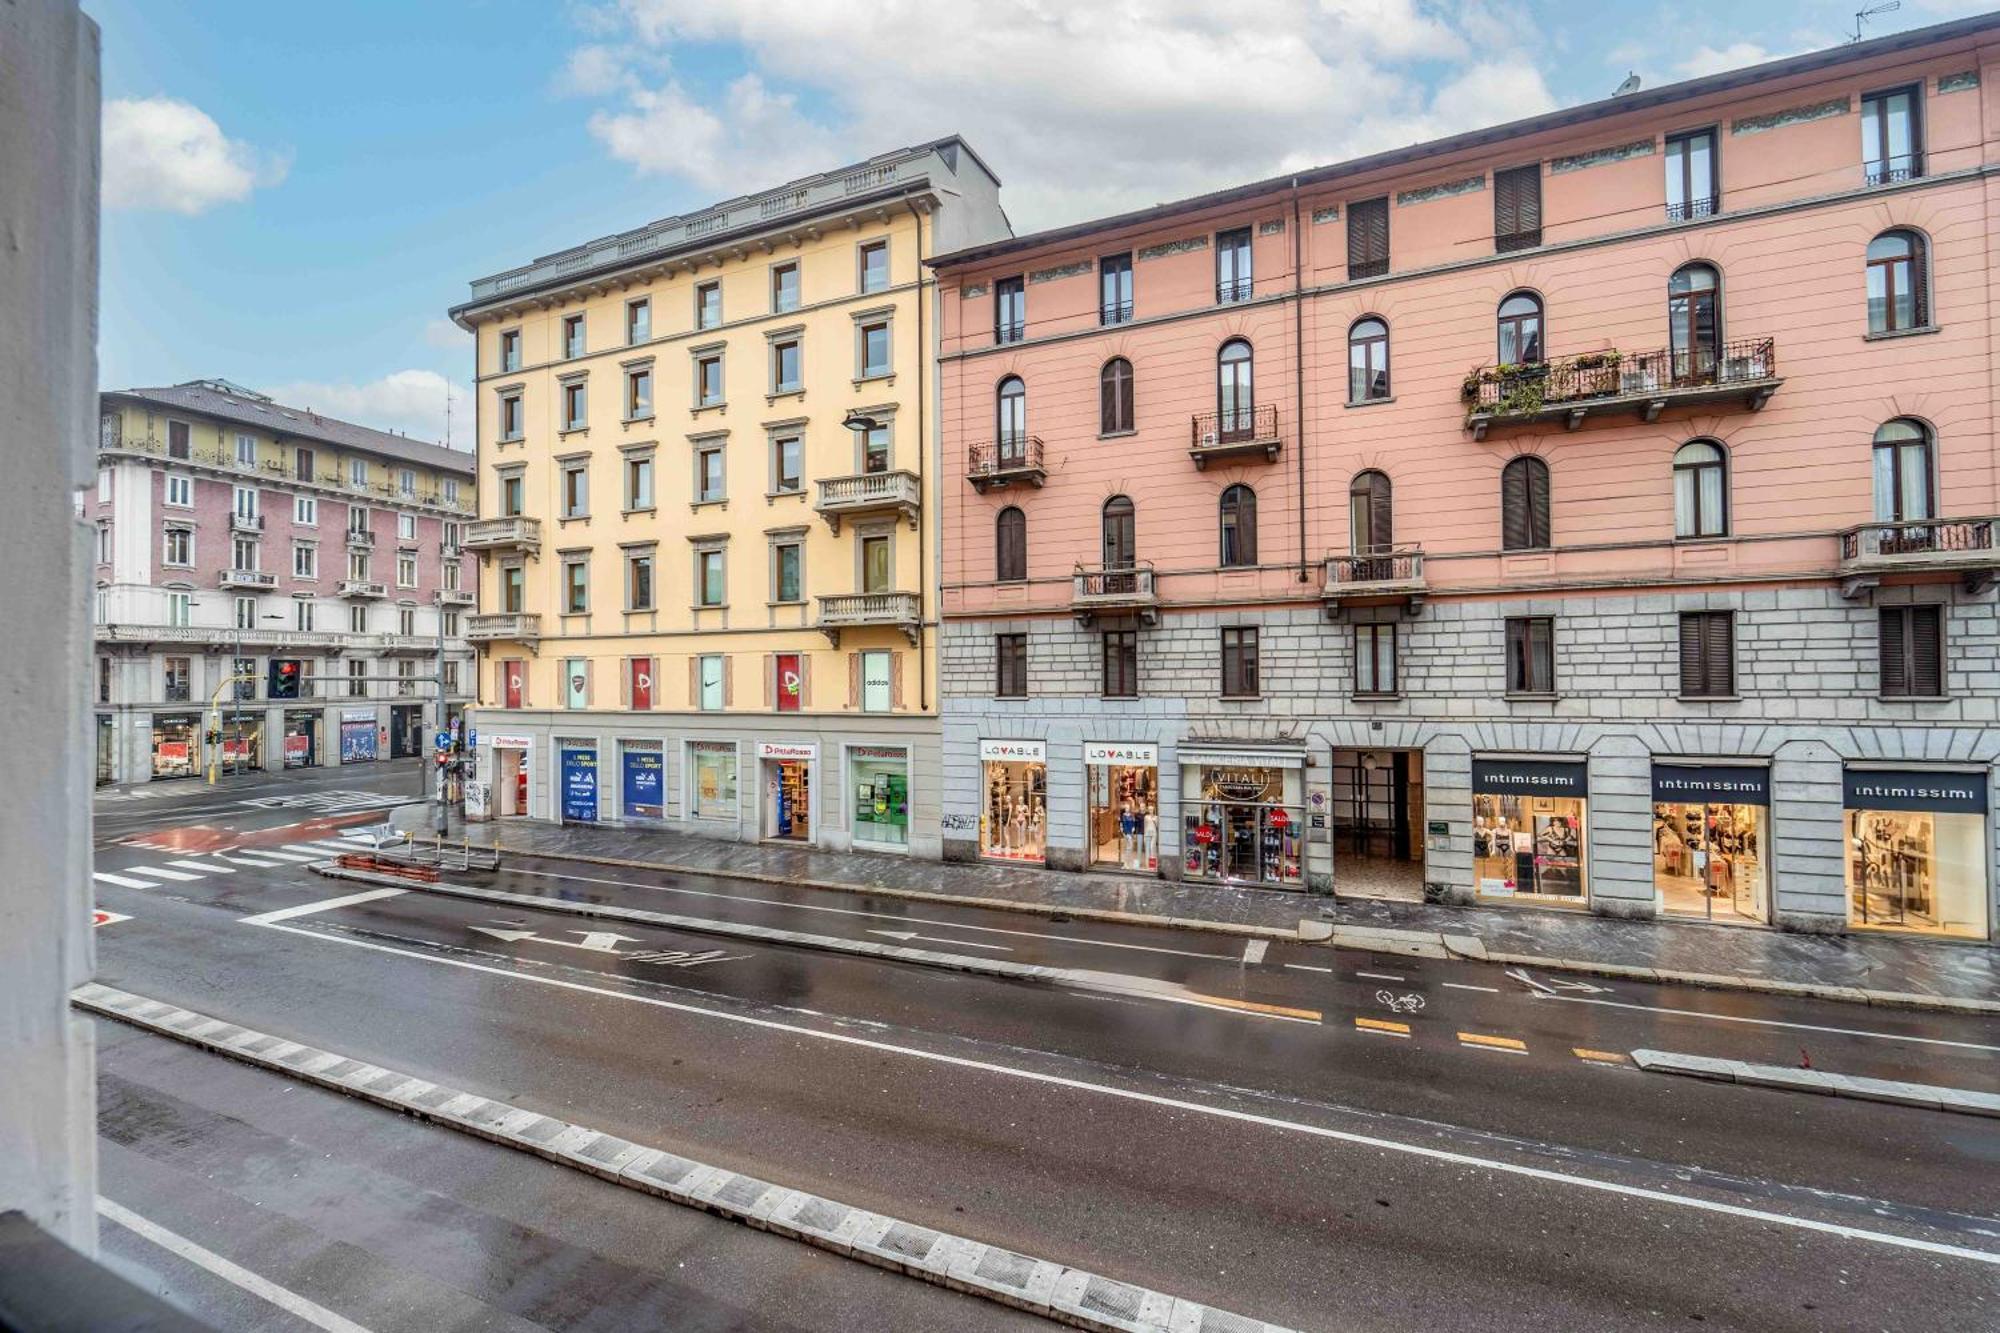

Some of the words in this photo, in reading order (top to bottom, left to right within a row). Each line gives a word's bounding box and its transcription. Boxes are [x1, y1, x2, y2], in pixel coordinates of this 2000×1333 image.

[984, 746, 1040, 757] LOVABLE
[1090, 749, 1151, 760] LOVABLE
[1217, 773, 1264, 784] VITALI
[1484, 773, 1575, 786] intimissimi
[1659, 779, 1762, 792] intimissimi
[1855, 785, 1974, 800] intimissimi
